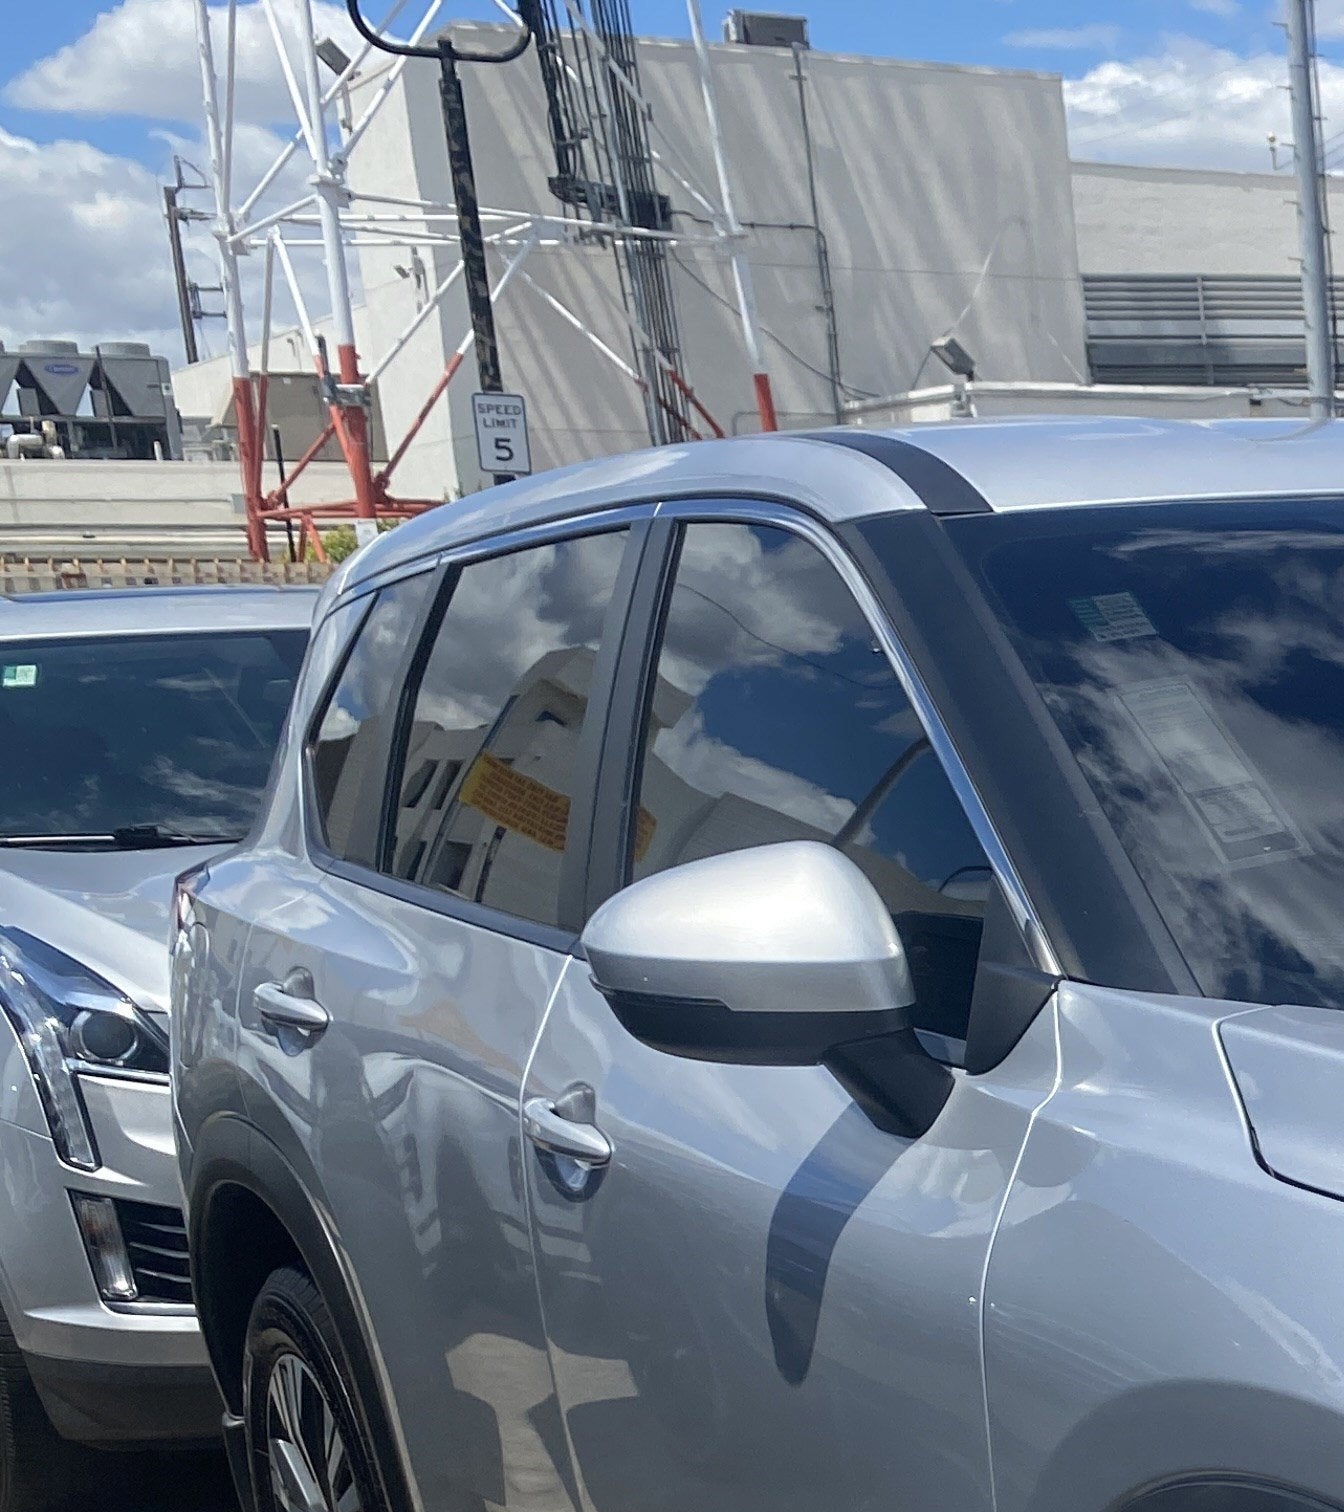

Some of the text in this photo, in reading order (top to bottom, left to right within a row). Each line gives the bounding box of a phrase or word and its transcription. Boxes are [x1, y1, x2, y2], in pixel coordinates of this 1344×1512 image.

[478, 404, 522, 415] SPEED
[483, 418, 517, 428] LIMIT
[494, 437, 514, 461] 5
